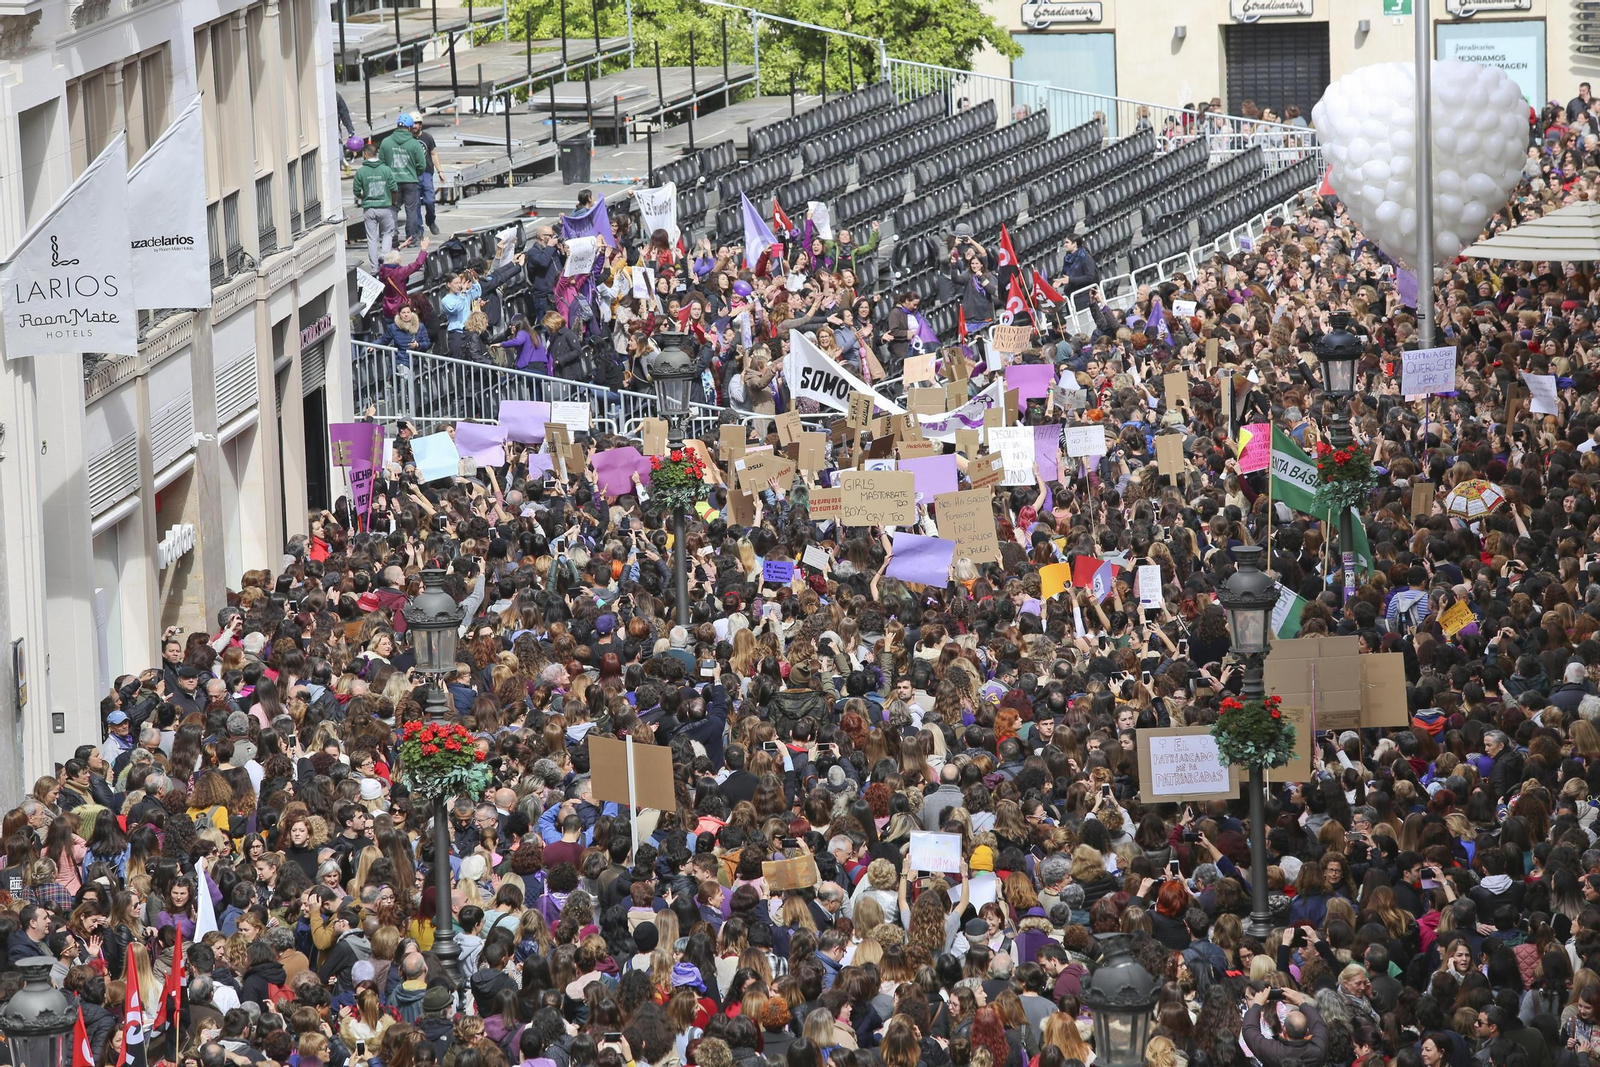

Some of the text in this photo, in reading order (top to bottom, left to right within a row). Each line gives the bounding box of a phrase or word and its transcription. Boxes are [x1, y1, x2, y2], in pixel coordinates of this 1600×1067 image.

[1033, 3, 1094, 21] Stradivarius
[1495, 62, 1528, 70] MAGEN
[16, 275, 119, 304] LARIOS
[46, 329, 93, 339] HOTELS
[1436, 358, 1455, 371] SER
[801, 367, 856, 402] SOMO
[843, 478, 875, 491] GIRLS
[860, 490, 908, 501] MASTURBATE
[955, 496, 965, 507] HA
[893, 500, 908, 508] TOO
[843, 505, 868, 518] BOYS
[866, 511, 905, 522] CRY TOO
[953, 520, 976, 534] ¡NO!
[955, 532, 993, 545] HE SALIDO
[956, 545, 990, 557] LA JAULA
[1174, 738, 1189, 752] EL
[1153, 752, 1214, 765] PATRIARCADO
[1175, 763, 1186, 773] ME
[1155, 769, 1224, 787] PATRIARCADAS
